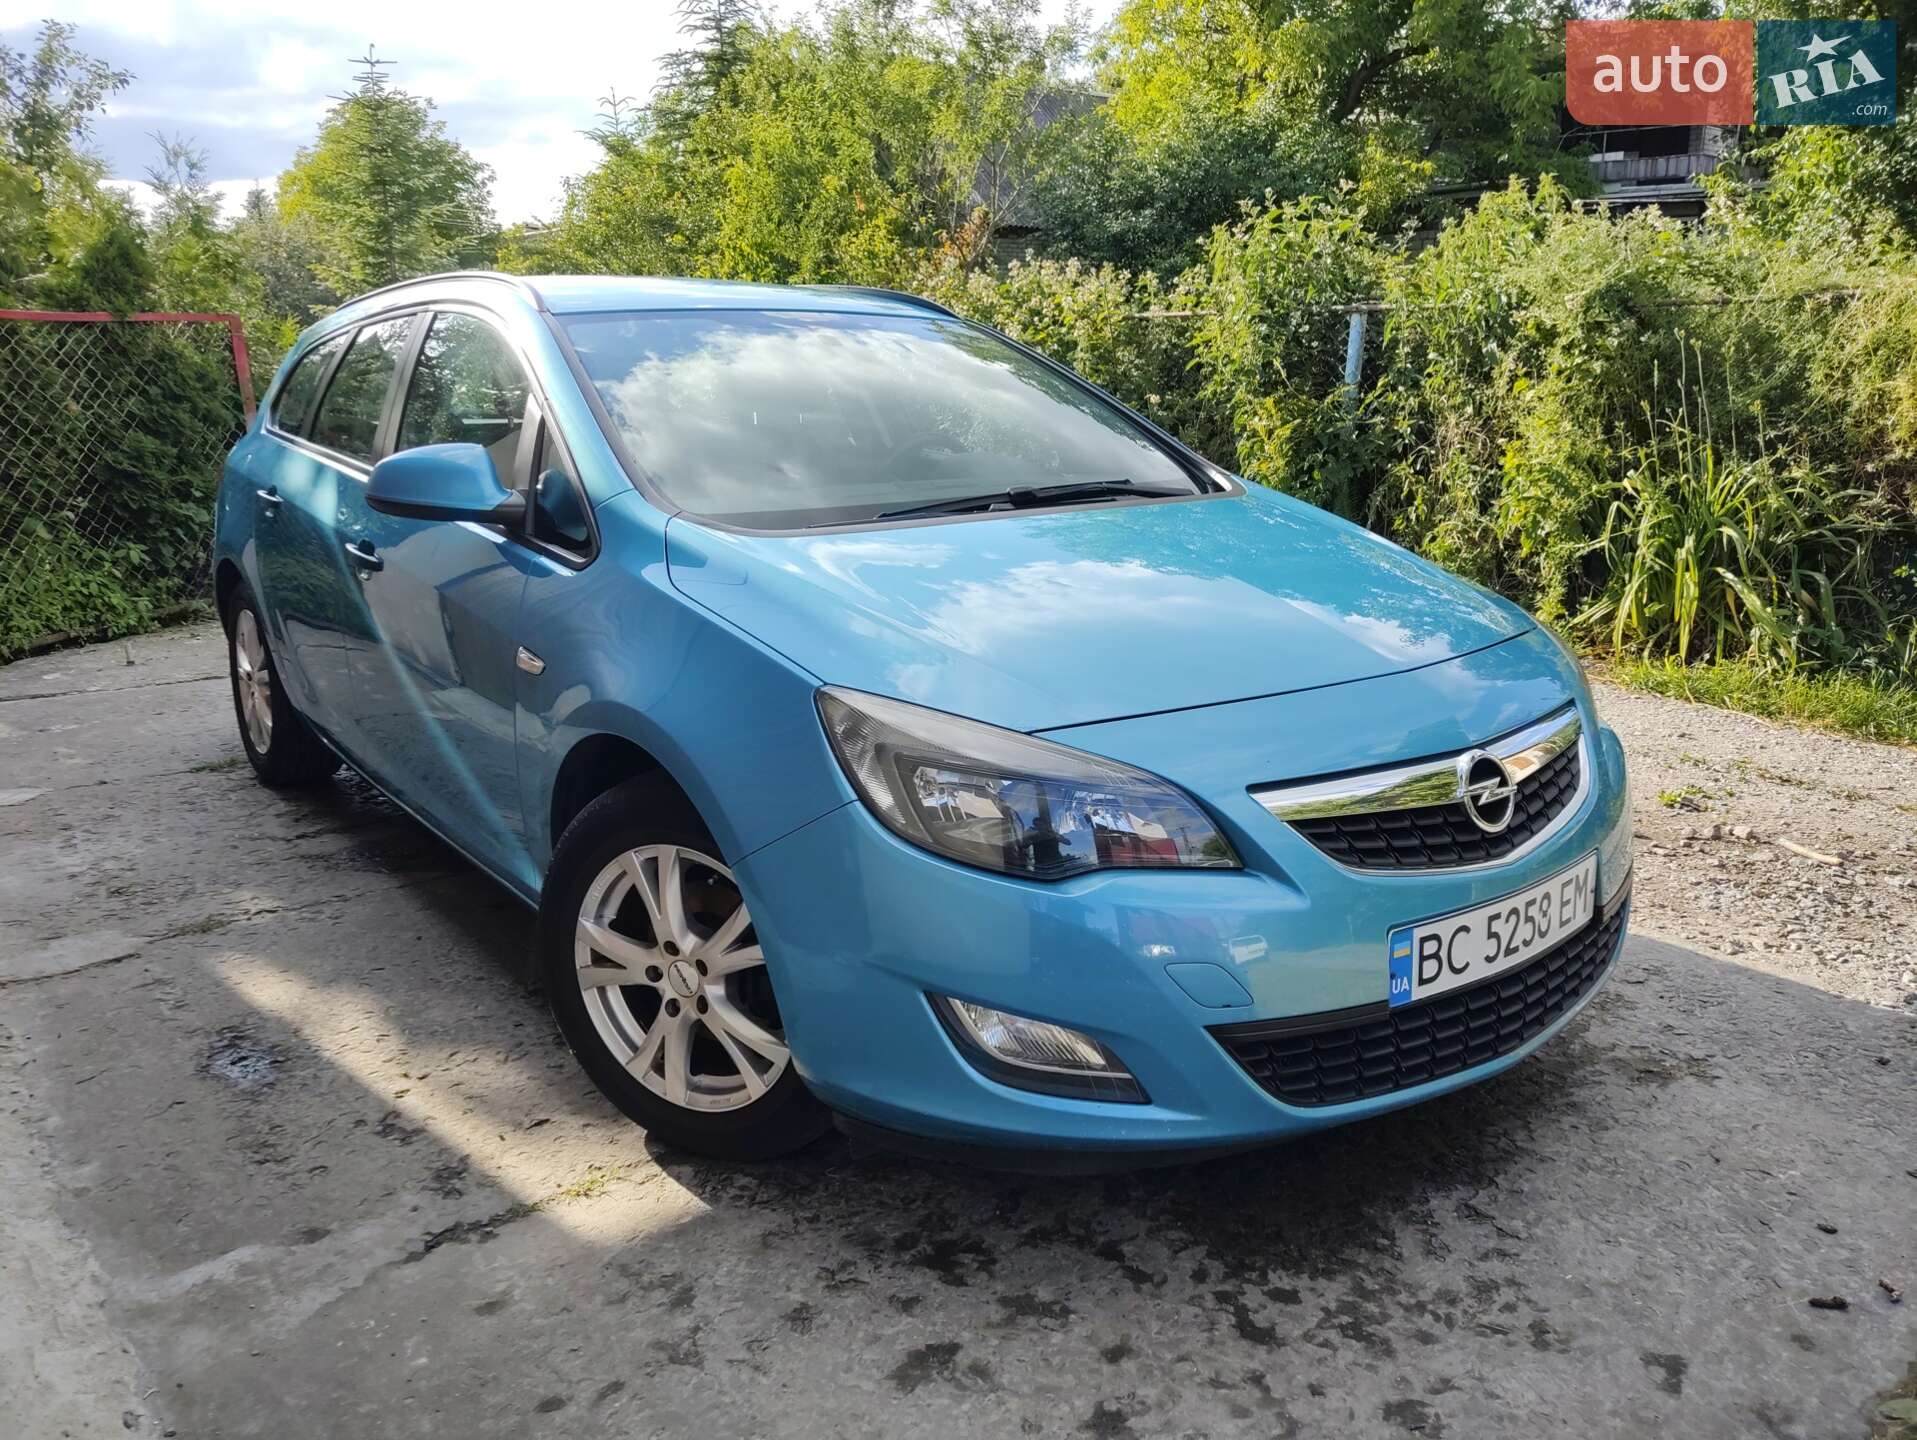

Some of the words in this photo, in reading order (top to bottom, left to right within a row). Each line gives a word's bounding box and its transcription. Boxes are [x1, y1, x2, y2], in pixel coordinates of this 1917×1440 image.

[1417, 924, 1472, 987] BC
[1559, 867, 1590, 929] EM
[1392, 976, 1410, 994] UA
